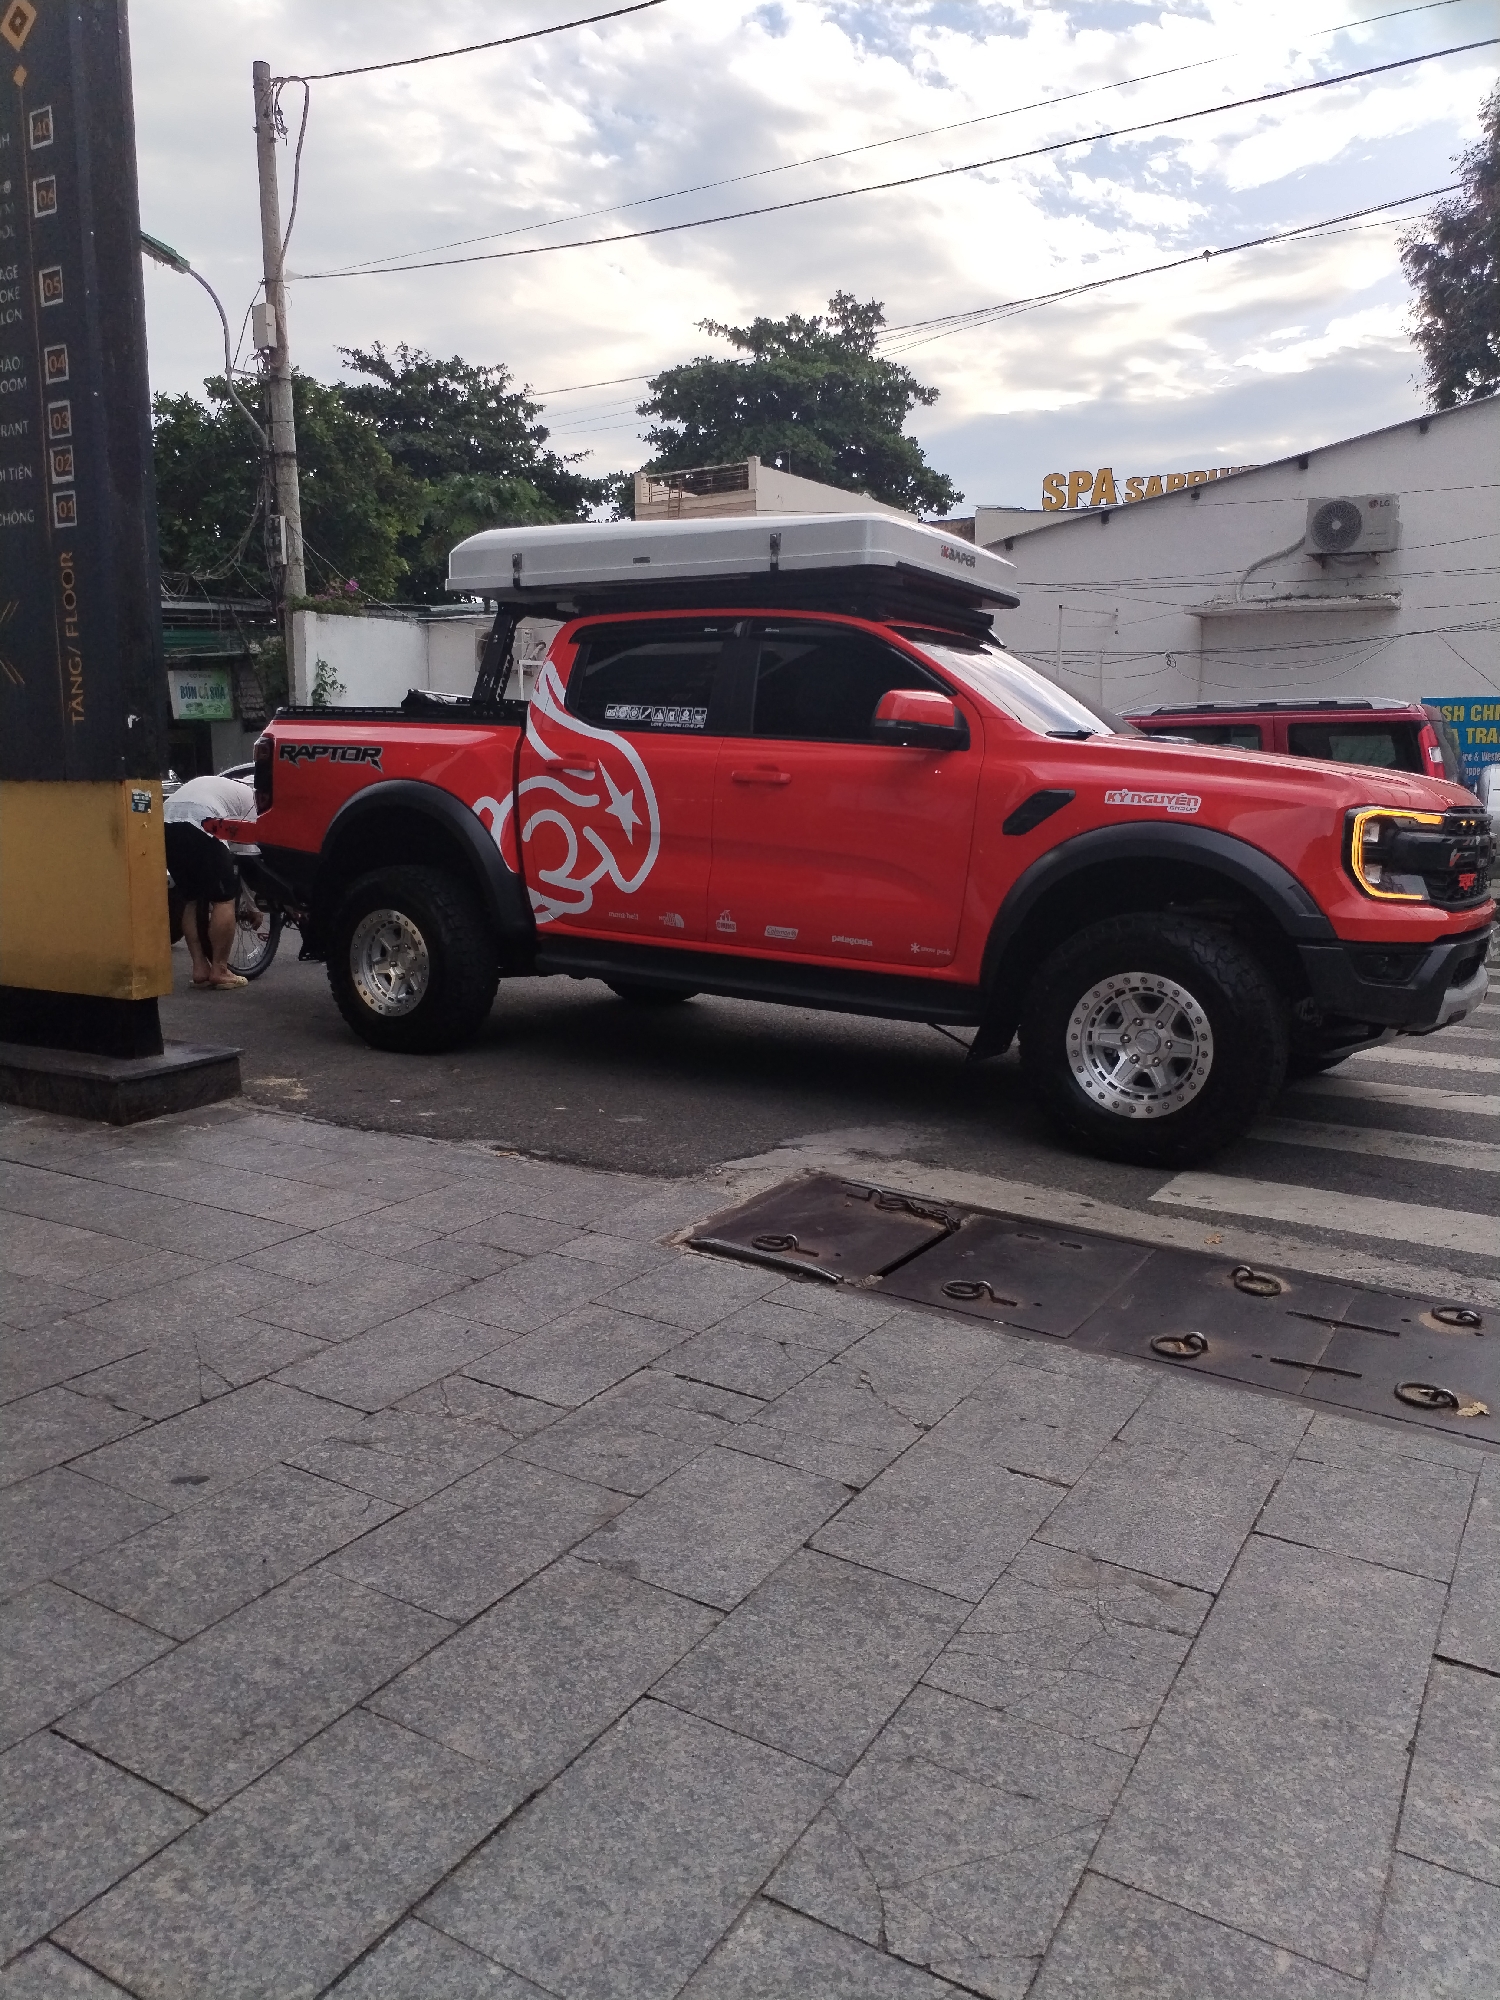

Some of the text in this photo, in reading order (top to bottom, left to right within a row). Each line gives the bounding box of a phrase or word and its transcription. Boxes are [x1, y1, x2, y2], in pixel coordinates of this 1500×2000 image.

[38, 187, 55, 208] 06
[44, 277, 61, 297] 05
[48, 354, 66, 373] 04
[1, 420, 29, 437] RANT
[53, 411, 70, 430] 03
[55, 454, 72, 472] 02
[1042, 467, 1118, 511] SPA
[58, 500, 75, 518] 01
[1379, 499, 1390, 508] LG
[60, 551, 80, 637] FLOOR
[279, 744, 384, 774] RAPTOR
[831, 935, 873, 947] patagonia
